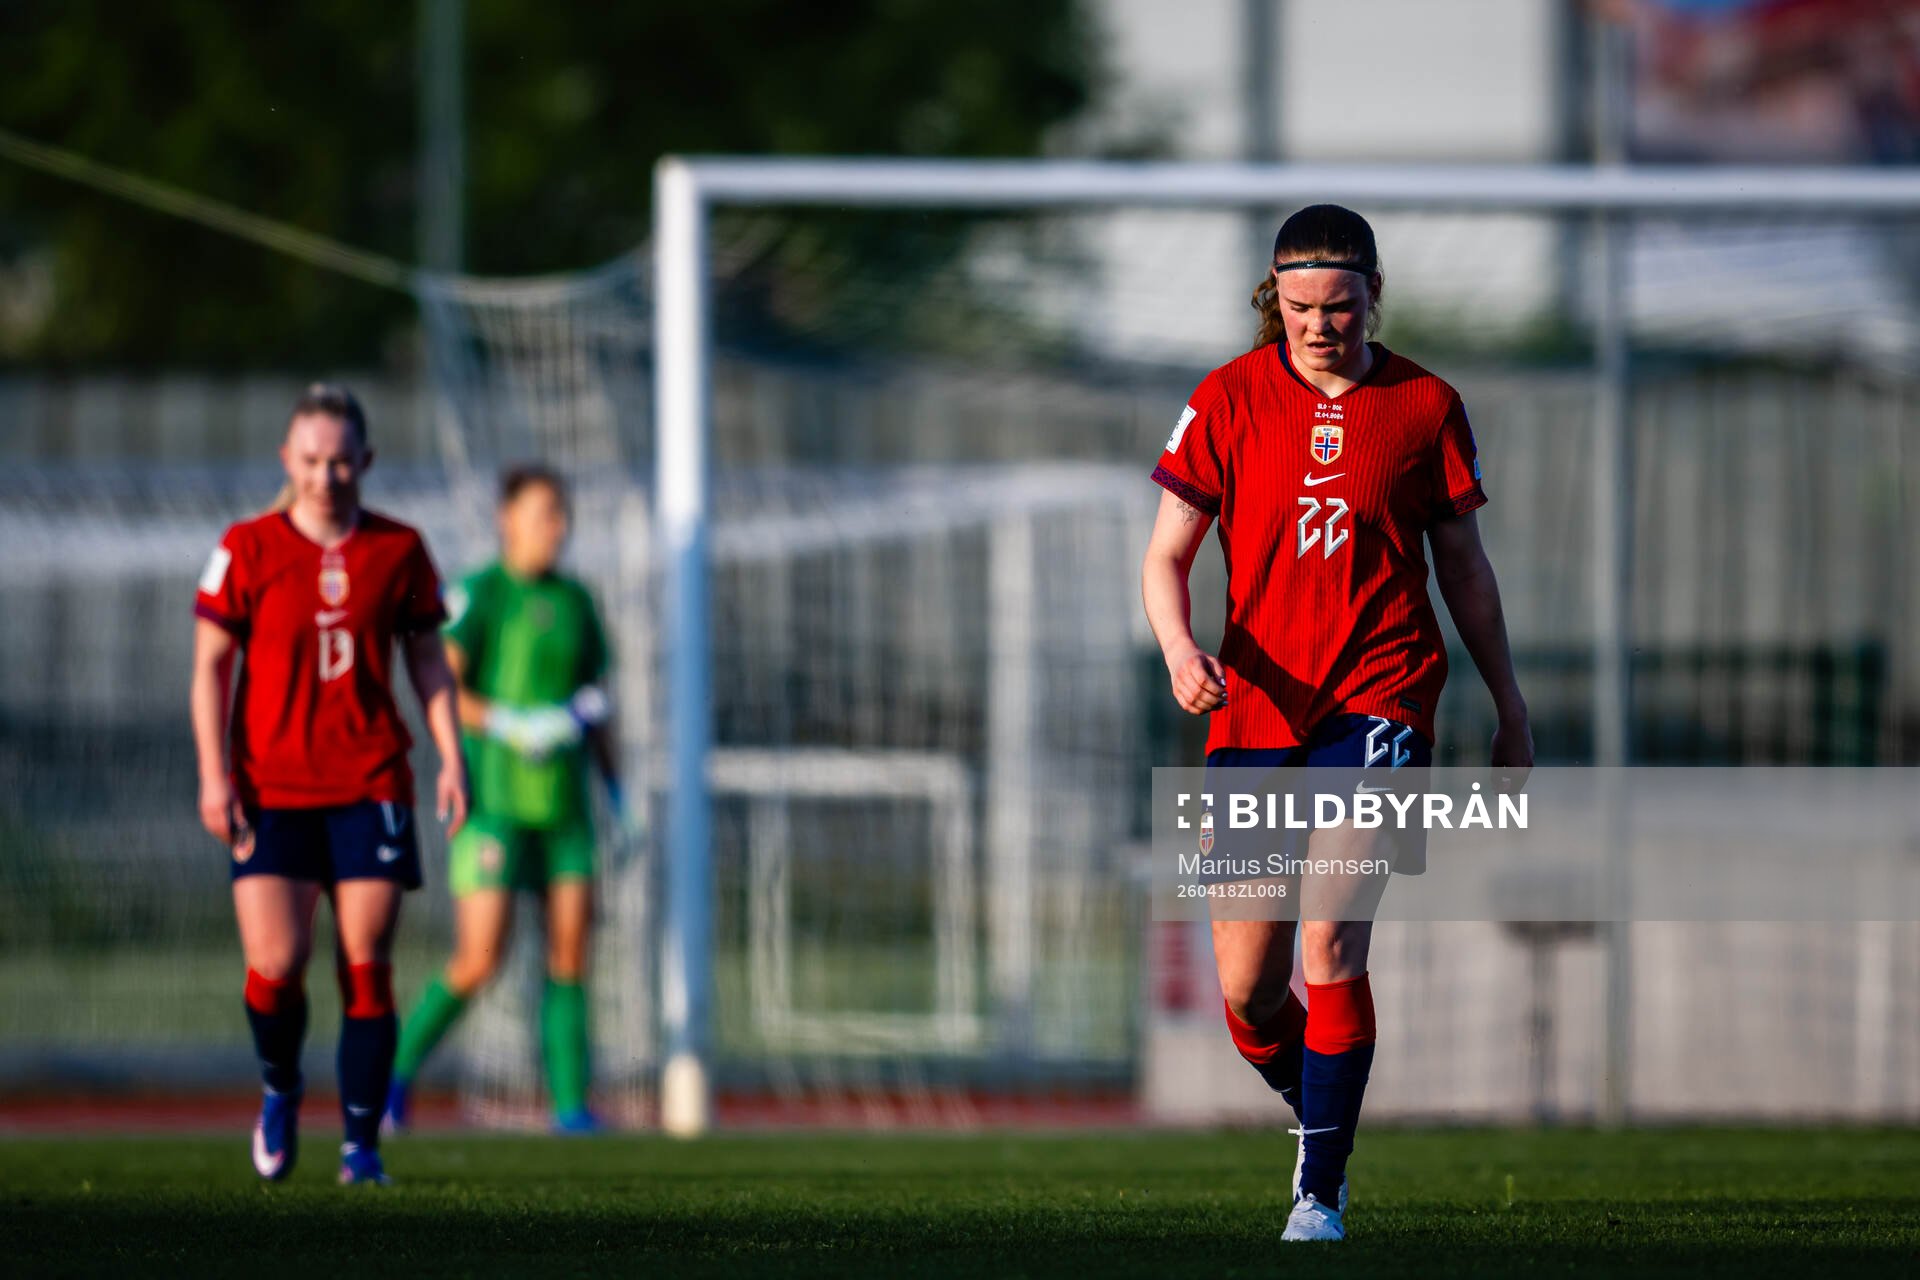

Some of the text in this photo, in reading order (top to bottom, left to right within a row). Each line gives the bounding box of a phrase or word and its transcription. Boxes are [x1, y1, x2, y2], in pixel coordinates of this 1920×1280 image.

[1298, 496, 1349, 560] 22
[318, 627, 355, 682] 13
[1364, 715, 1413, 773] 22
